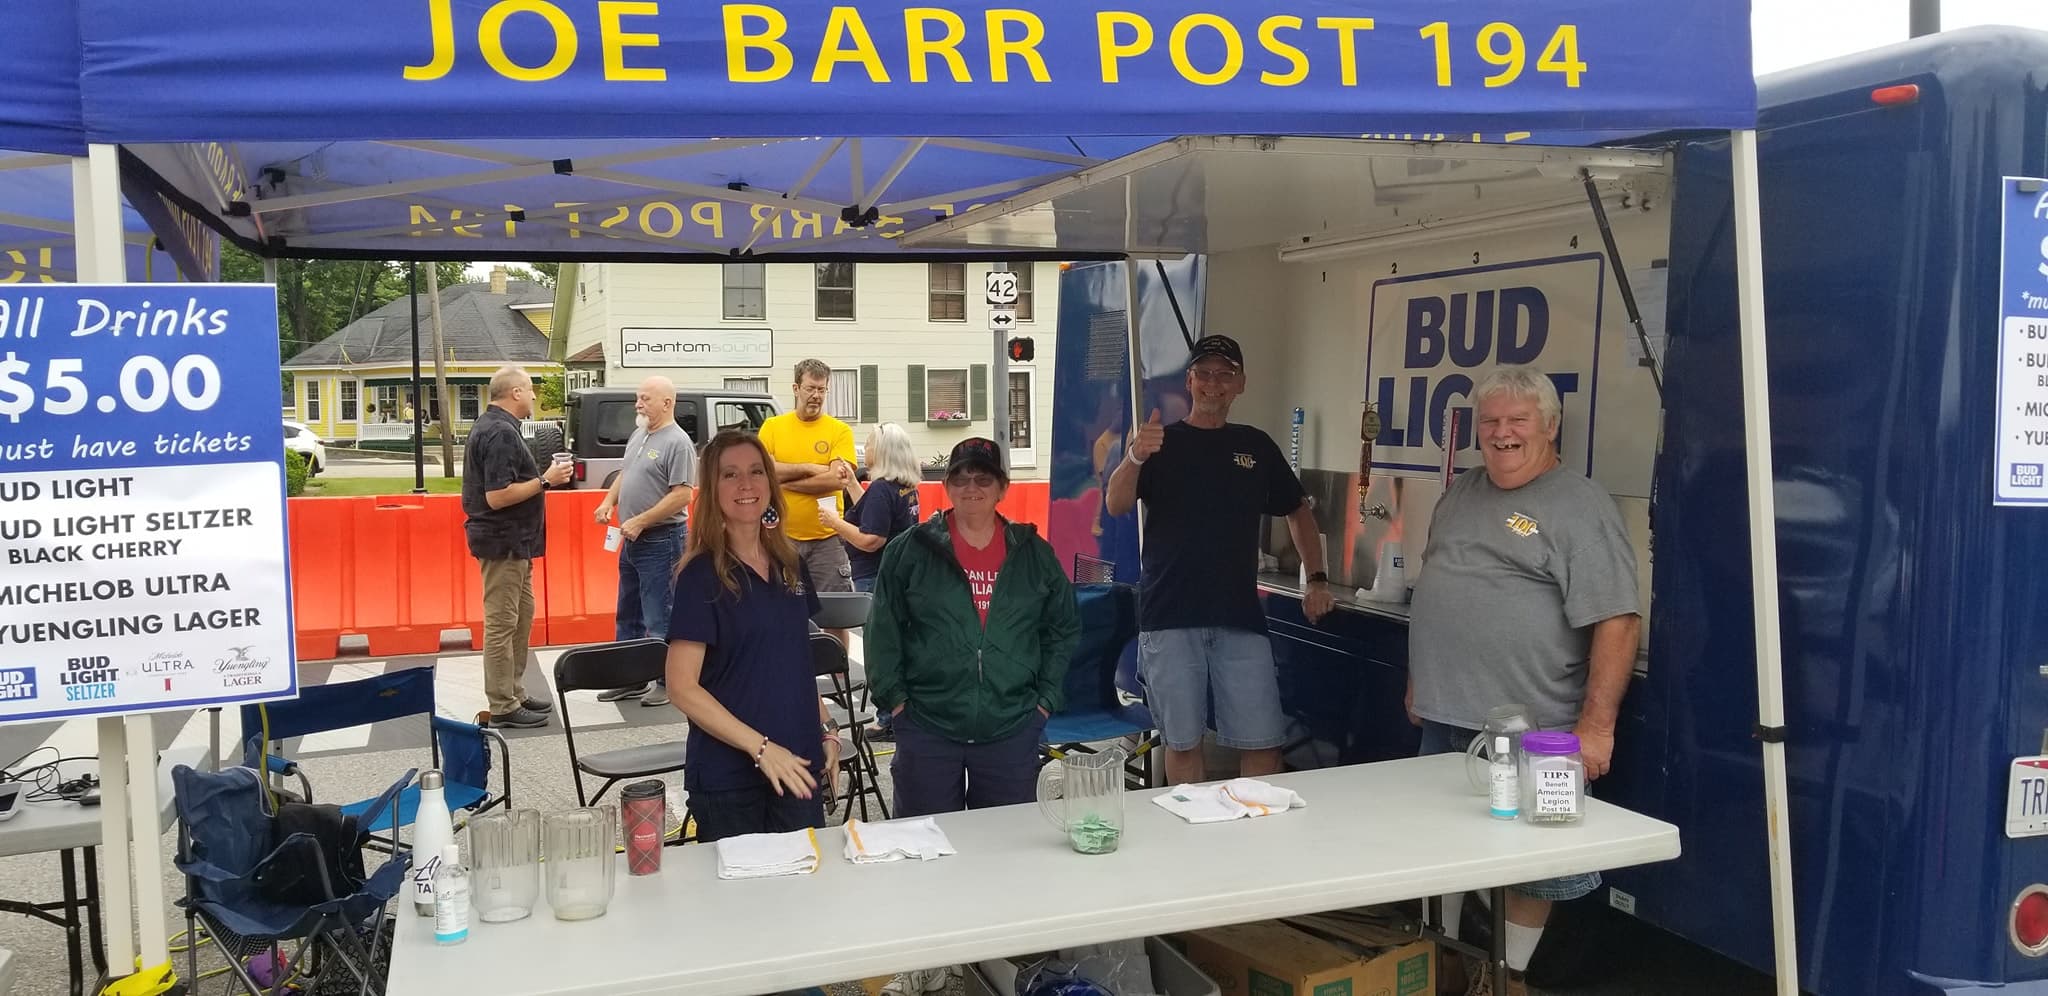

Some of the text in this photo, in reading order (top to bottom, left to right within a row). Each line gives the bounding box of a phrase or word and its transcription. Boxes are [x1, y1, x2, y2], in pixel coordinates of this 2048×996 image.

[403, 0, 1588, 88] JOE BARR POST 194
[1472, 251, 1480, 265] 3
[1391, 262, 1398, 274] 2
[989, 279, 1014, 297] 42
[70, 297, 229, 338] Drinks
[1404, 285, 1550, 369] BUD
[0, 351, 222, 424] $5.00
[1375, 372, 1579, 452] LIGT
[72, 434, 137, 458] have
[154, 430, 252, 455] tickets
[2016, 464, 2039, 475] BUD
[2012, 474, 2042, 487] LIGHT
[0, 477, 134, 502] UD LIGHT
[0, 508, 253, 540] UD LIGHT SELTZER
[8, 539, 183, 564] BLACK CHERRY
[964, 569, 984, 581] AN
[145, 572, 231, 596] ULTRA
[174, 607, 262, 632] LAGER
[67, 655, 110, 671] BUD
[142, 659, 195, 672] ULTRA
[213, 658, 270, 675] Yuengling
[0, 670, 25, 685] UD
[60, 668, 120, 685] LIGHT
[223, 676, 262, 687] LAGER
[0, 683, 34, 699] GHT
[66, 684, 115, 701] SELTZER
[1543, 771, 1569, 779] TIPS
[1537, 788, 1575, 796] American
[1542, 797, 1569, 806] Legion
